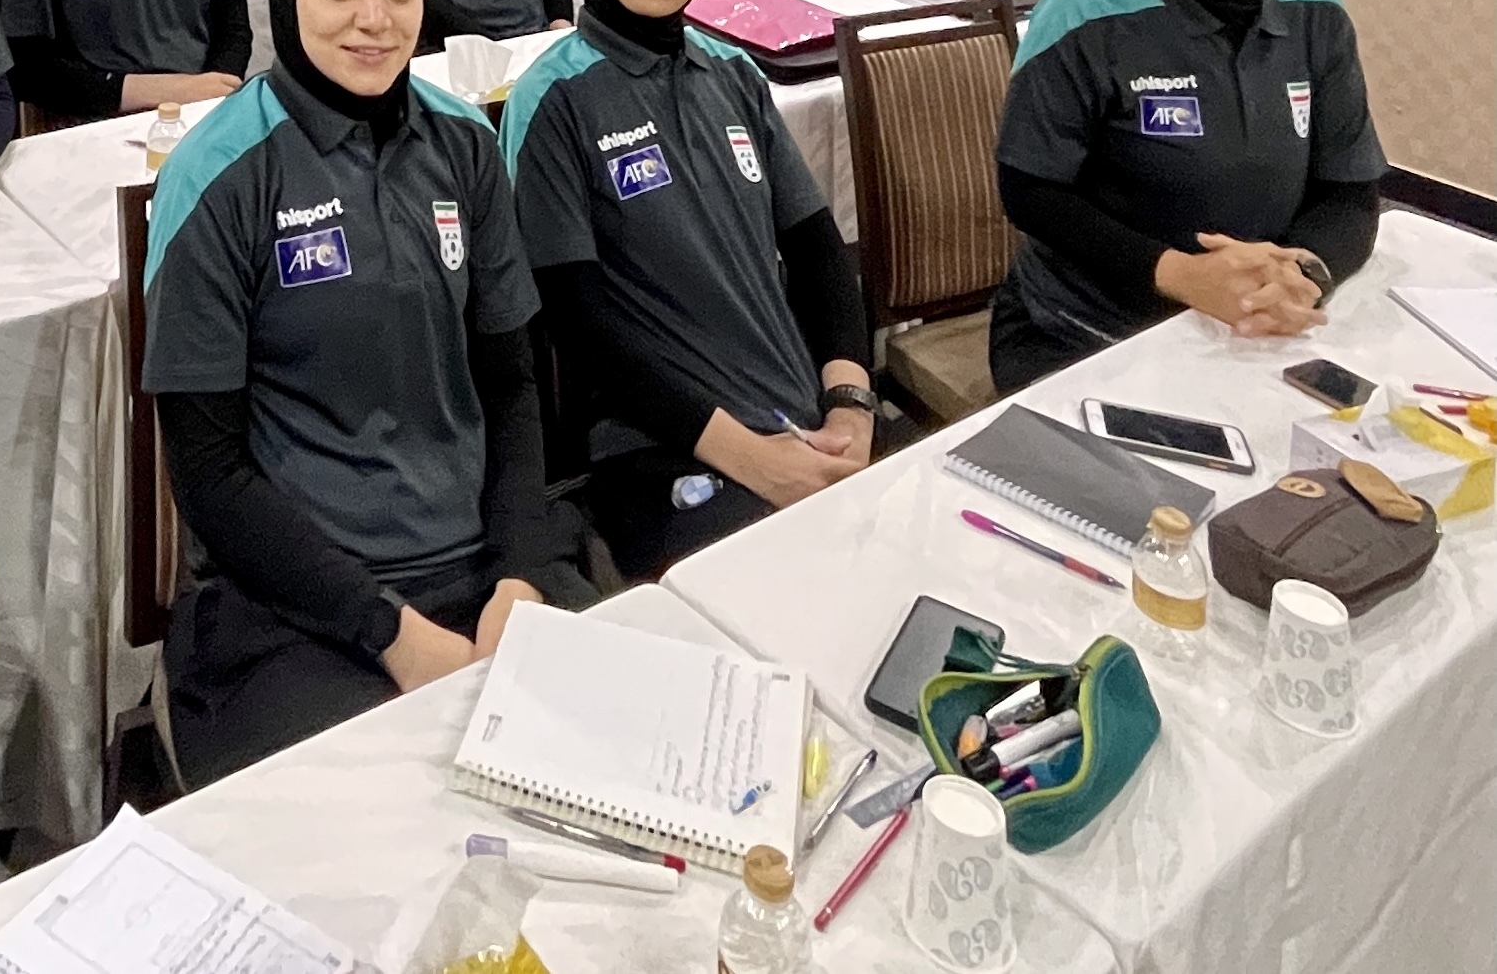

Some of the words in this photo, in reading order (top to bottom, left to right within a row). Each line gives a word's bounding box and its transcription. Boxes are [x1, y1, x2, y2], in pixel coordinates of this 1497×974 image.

[1129, 74, 1199, 92] uhlsport
[1149, 106, 1191, 126] AFC
[597, 120, 658, 152] uhlsport
[621, 158, 659, 188] AFC
[288, 243, 338, 274] AFC
